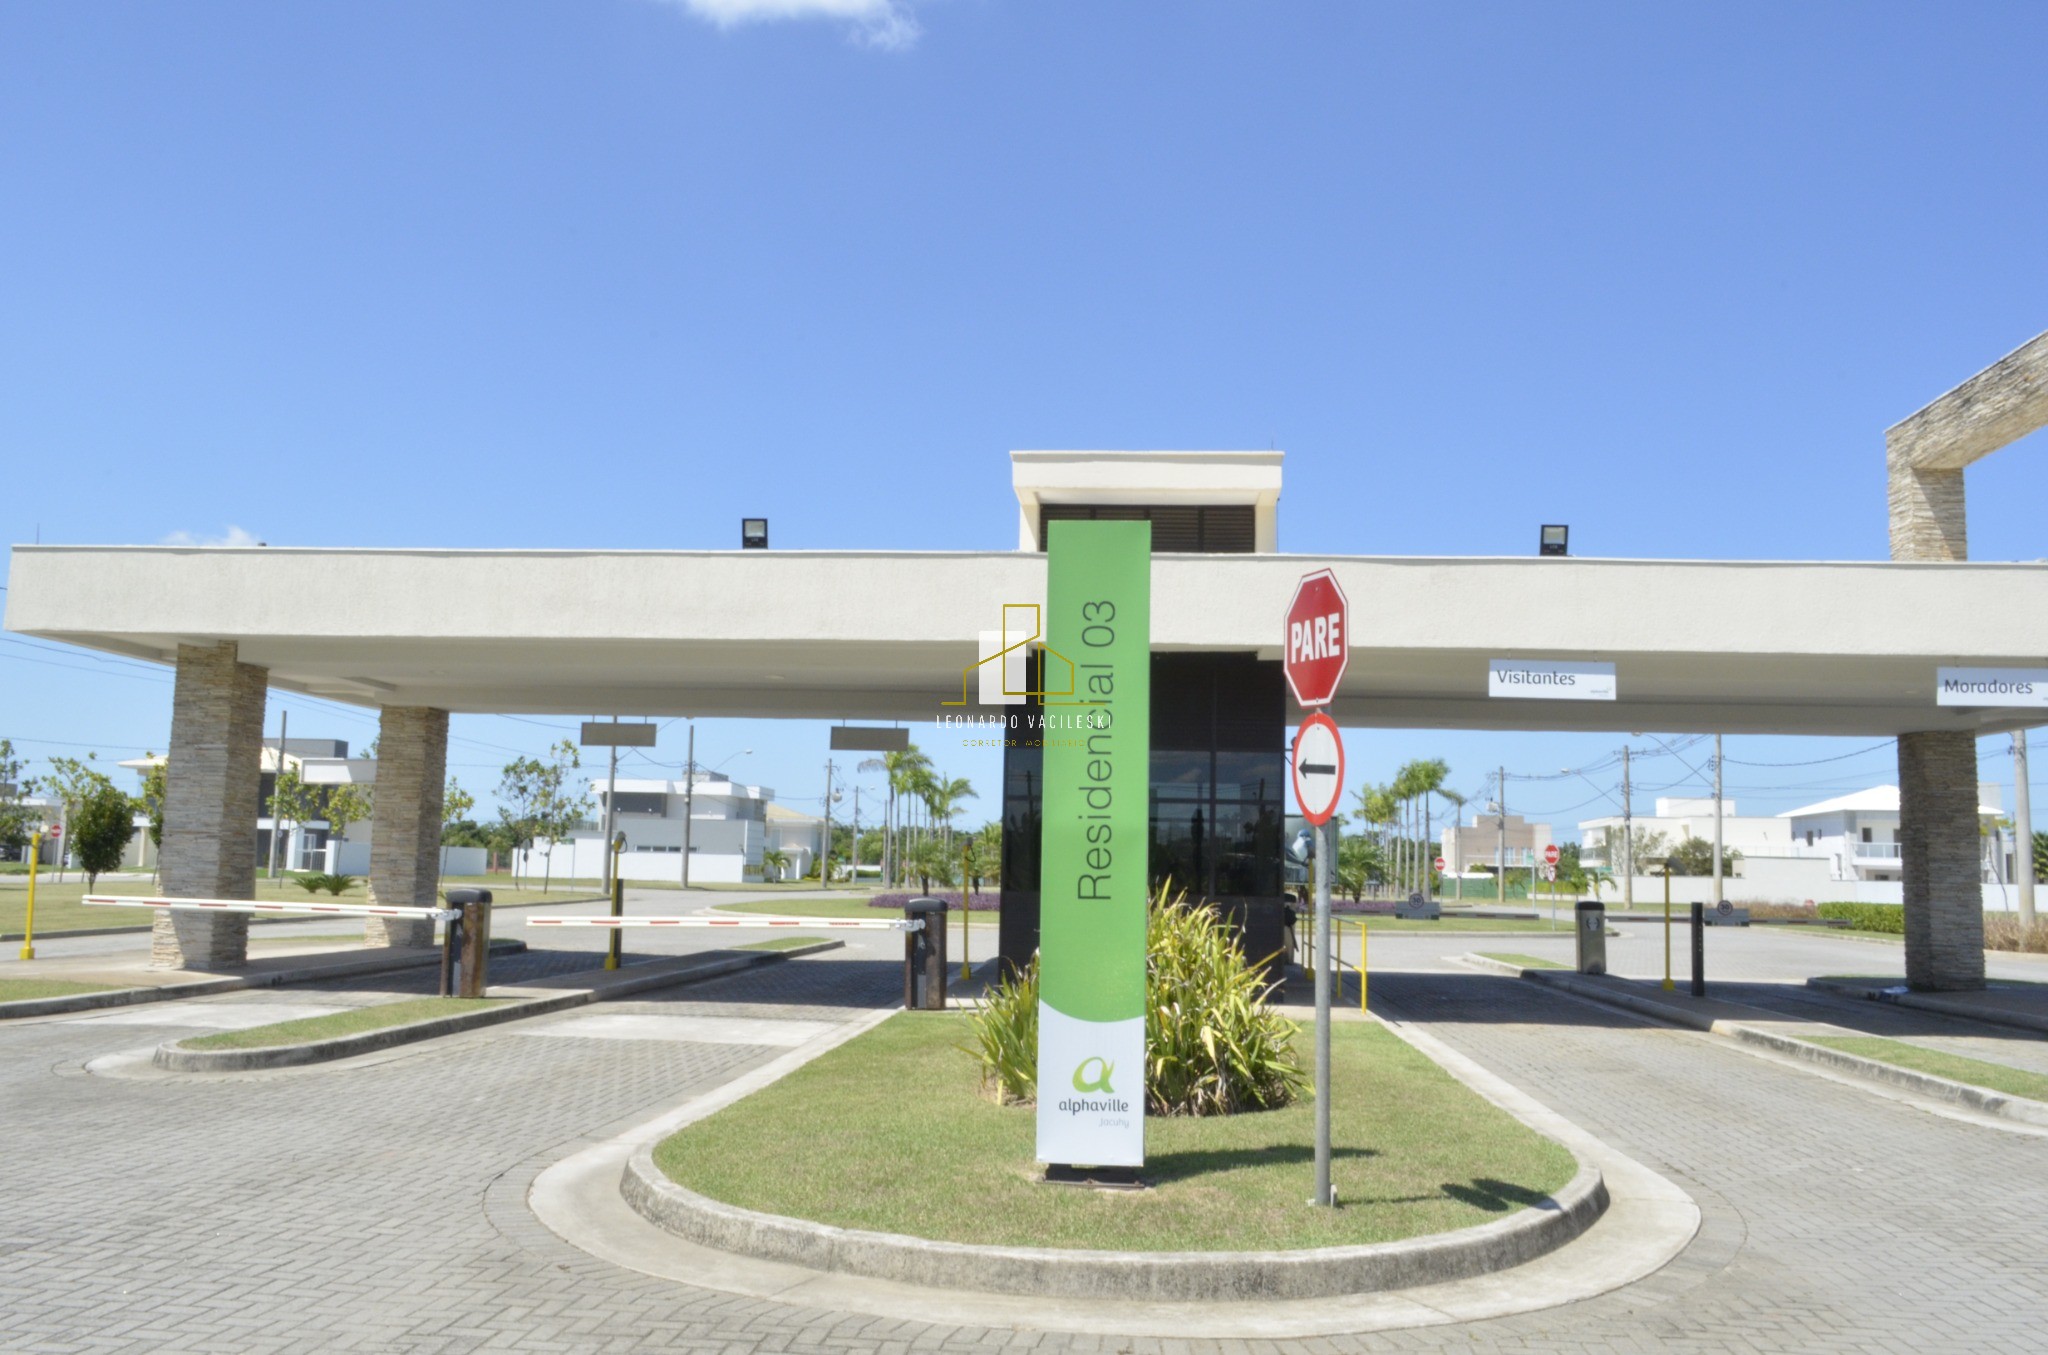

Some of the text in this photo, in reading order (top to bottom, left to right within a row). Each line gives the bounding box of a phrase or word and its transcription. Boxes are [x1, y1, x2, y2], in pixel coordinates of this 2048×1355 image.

[1291, 612, 1340, 664] PARE
[1497, 669, 1576, 686] Visitantes
[1944, 679, 2033, 694] Moradores
[1078, 600, 1117, 900] Residencial 03
[1058, 1098, 1129, 1116] alphaville
